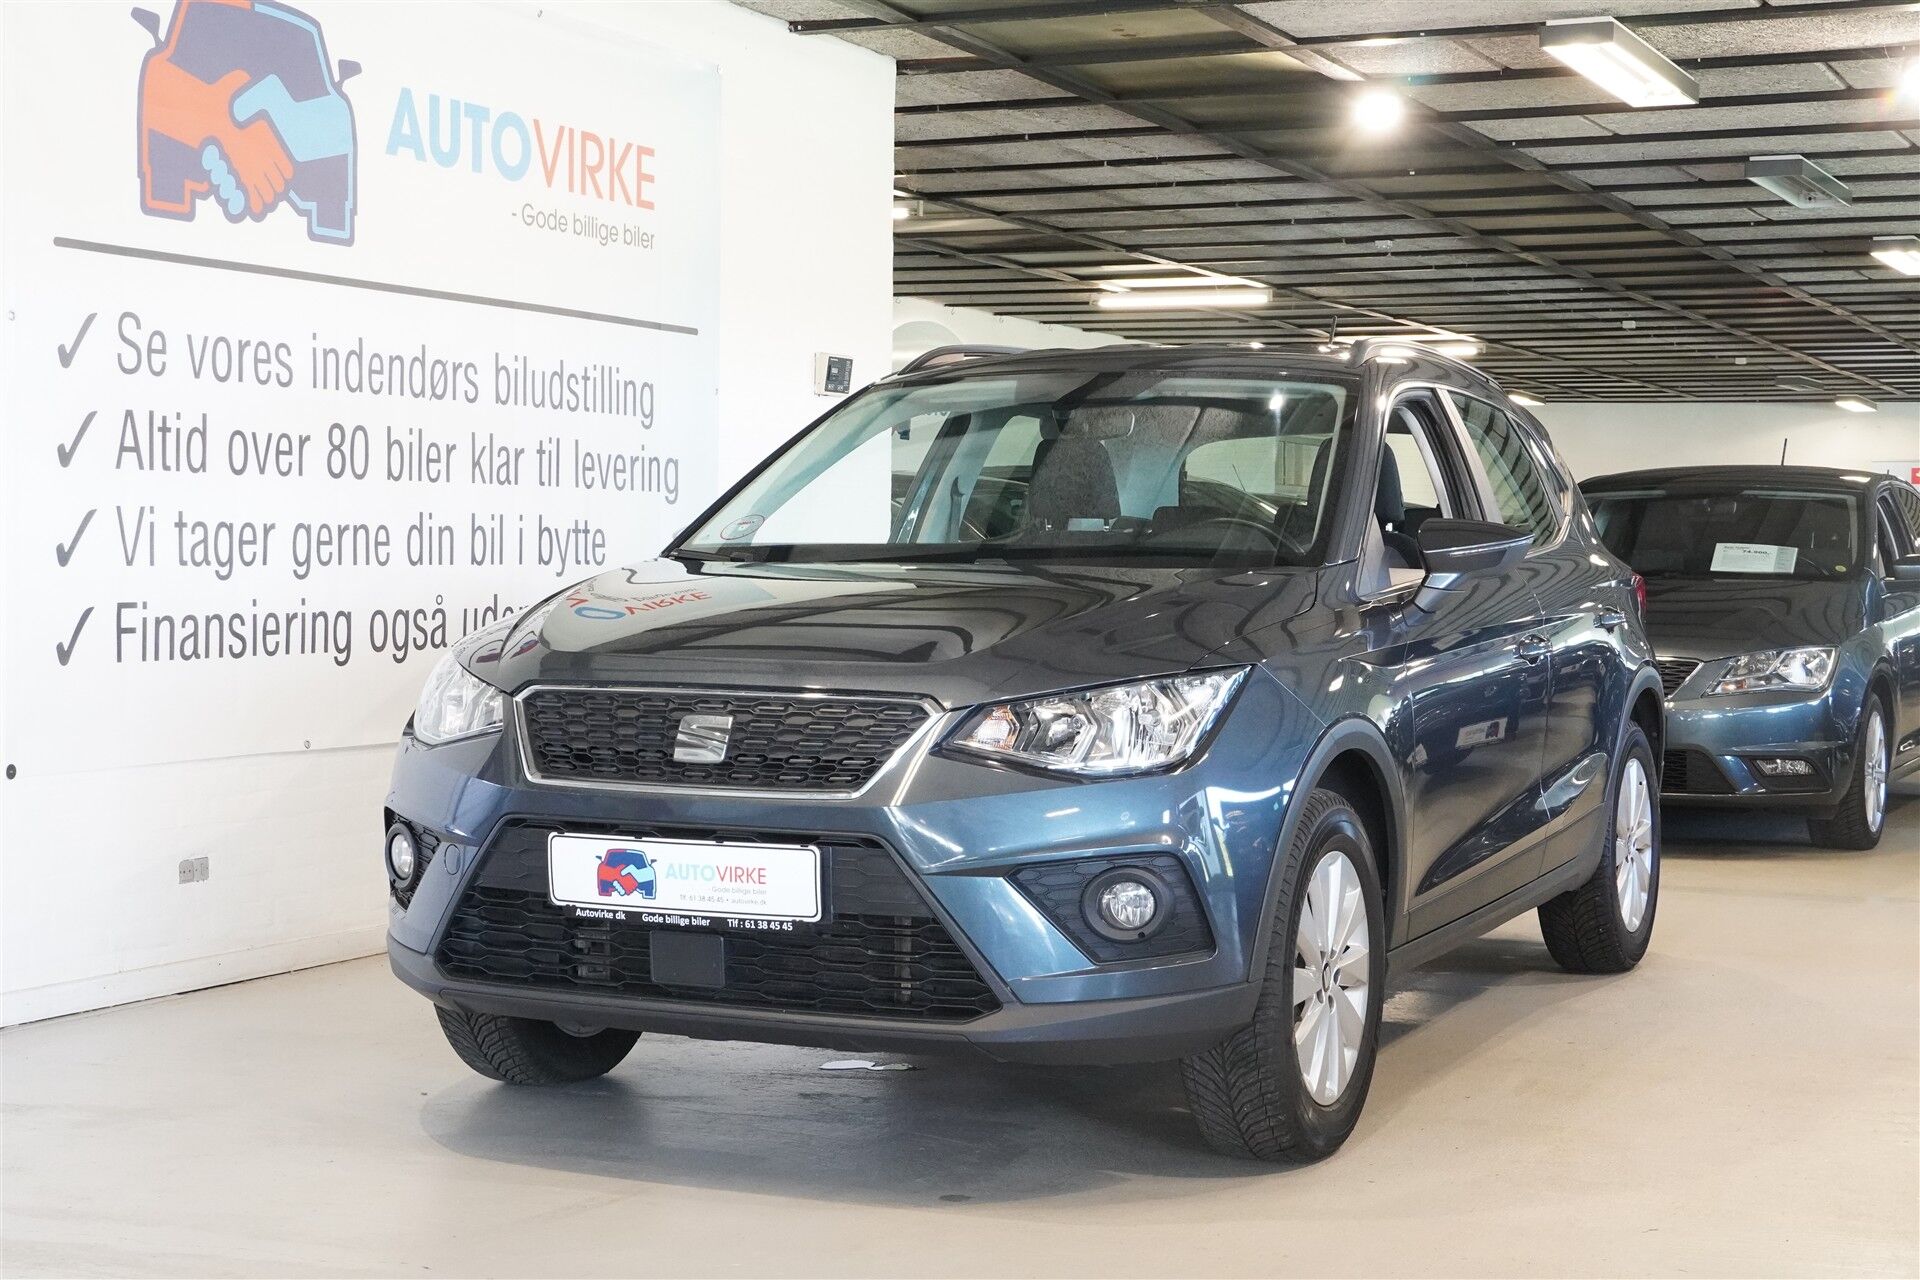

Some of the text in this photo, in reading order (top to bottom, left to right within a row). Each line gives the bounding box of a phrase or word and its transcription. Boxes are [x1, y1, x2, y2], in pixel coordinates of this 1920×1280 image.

[385, 87, 655, 210] AUTOVIRKE
[522, 203, 567, 232] Gode
[573, 213, 618, 246] billige
[624, 224, 655, 250] biler
[117, 311, 654, 429] Se vores indendørs biludstilling
[115, 409, 679, 505] Altid over 80 biler klar til levering
[116, 505, 606, 581] Vi tager gerne din bil i bytte
[116, 598, 352, 666] Finansiering
[369, 594, 448, 663] også
[665, 863, 767, 885] AUTOVIRKE
[576, 908, 613, 919] Autovirke
[642, 913, 664, 923] Gode
[665, 915, 690, 926] billige
[691, 916, 711, 926] biler
[727, 919, 739, 928] Tlf
[745, 920, 756, 929] 61
[757, 920, 768, 929] 38
[769, 921, 780, 930] 45
[782, 922, 793, 931] 45
